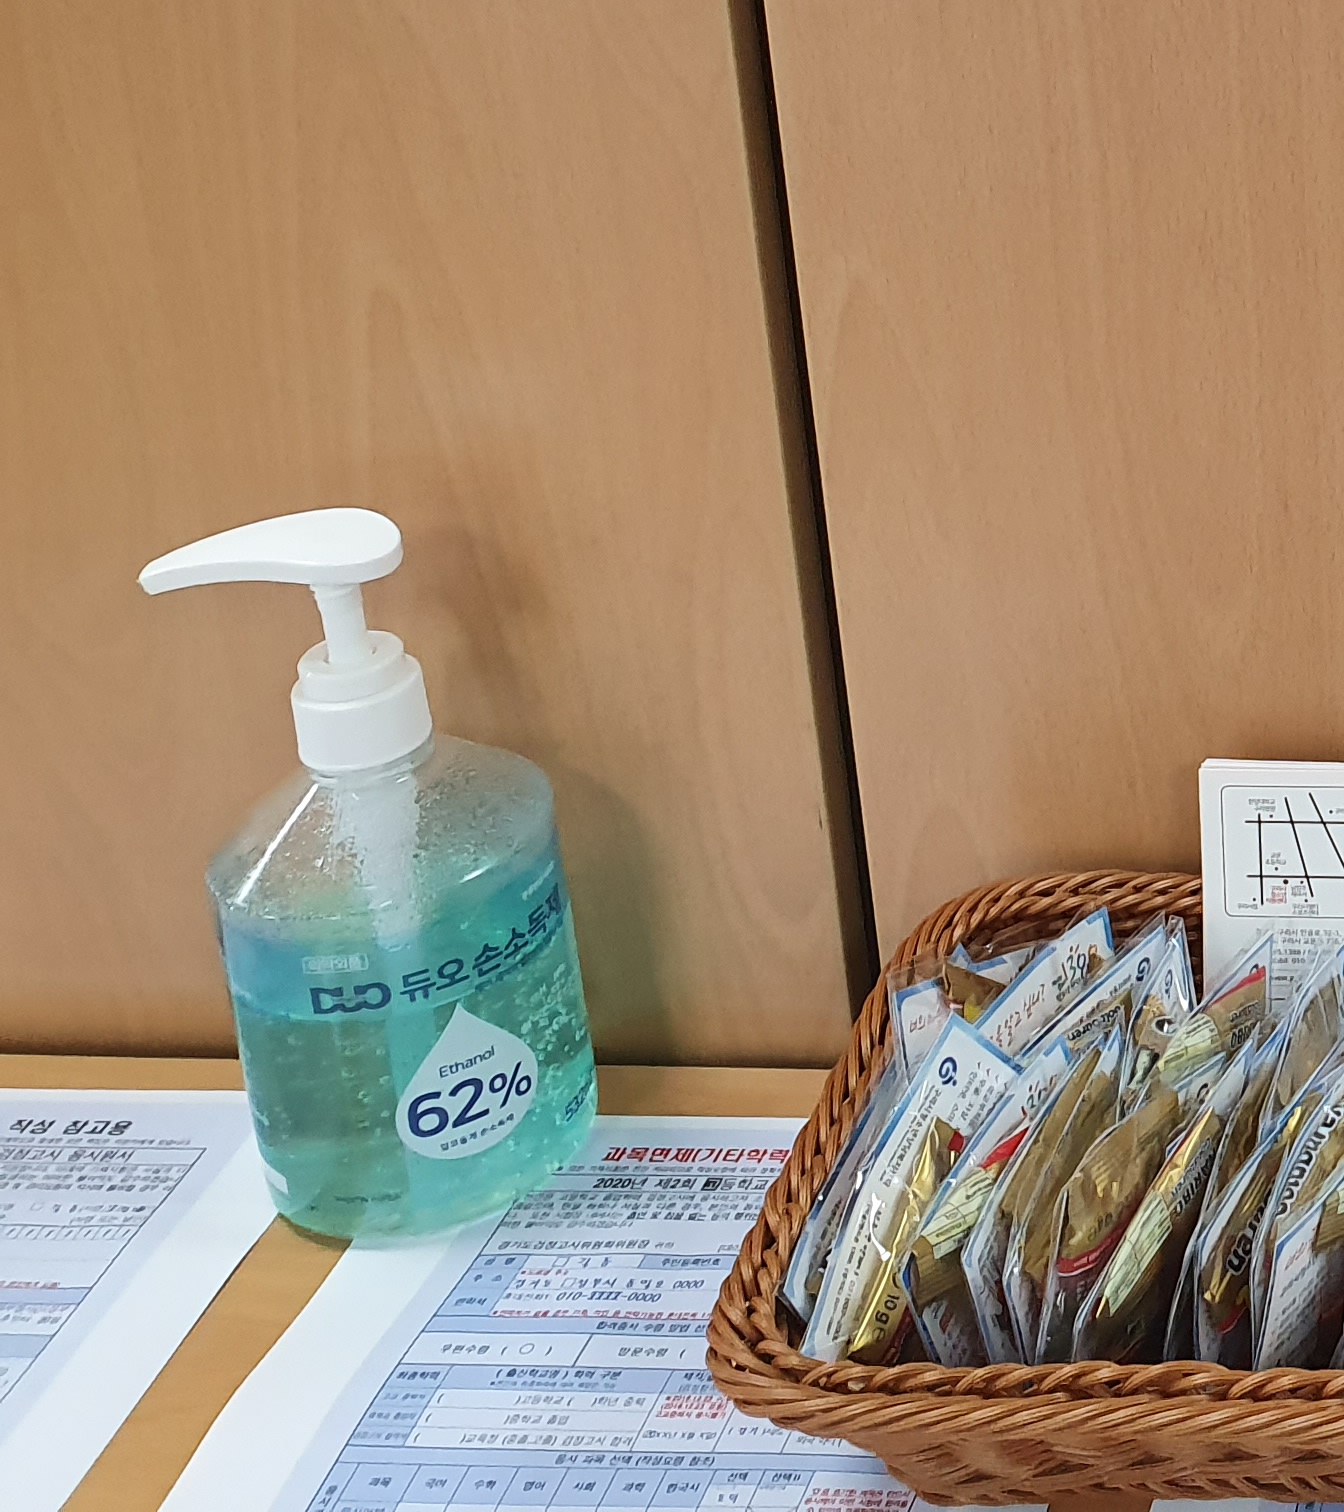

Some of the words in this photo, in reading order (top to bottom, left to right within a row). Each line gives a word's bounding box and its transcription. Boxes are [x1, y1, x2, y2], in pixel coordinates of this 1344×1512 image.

[400, 958, 470, 1002] 듀오
[439, 1046, 495, 1078] Ethanol
[407, 1061, 532, 1139] 62%
[10, 1119, 55, 1134] 작성
[63, 1120, 132, 1135] 참고용
[592, 1178, 648, 1190] 2020년
[654, 1178, 698, 1190] 제2회
[700, 1178, 769, 1191] 고등학교
[617, 1346, 668, 1358] 방문수령
[600, 1370, 623, 1380] 구분
[424, 1478, 448, 1489] 국어
[474, 1480, 497, 1490] 수학
[523, 1480, 546, 1491] 영어
[573, 1480, 596, 1492] 사회
[667, 1481, 701, 1492] 한국사
